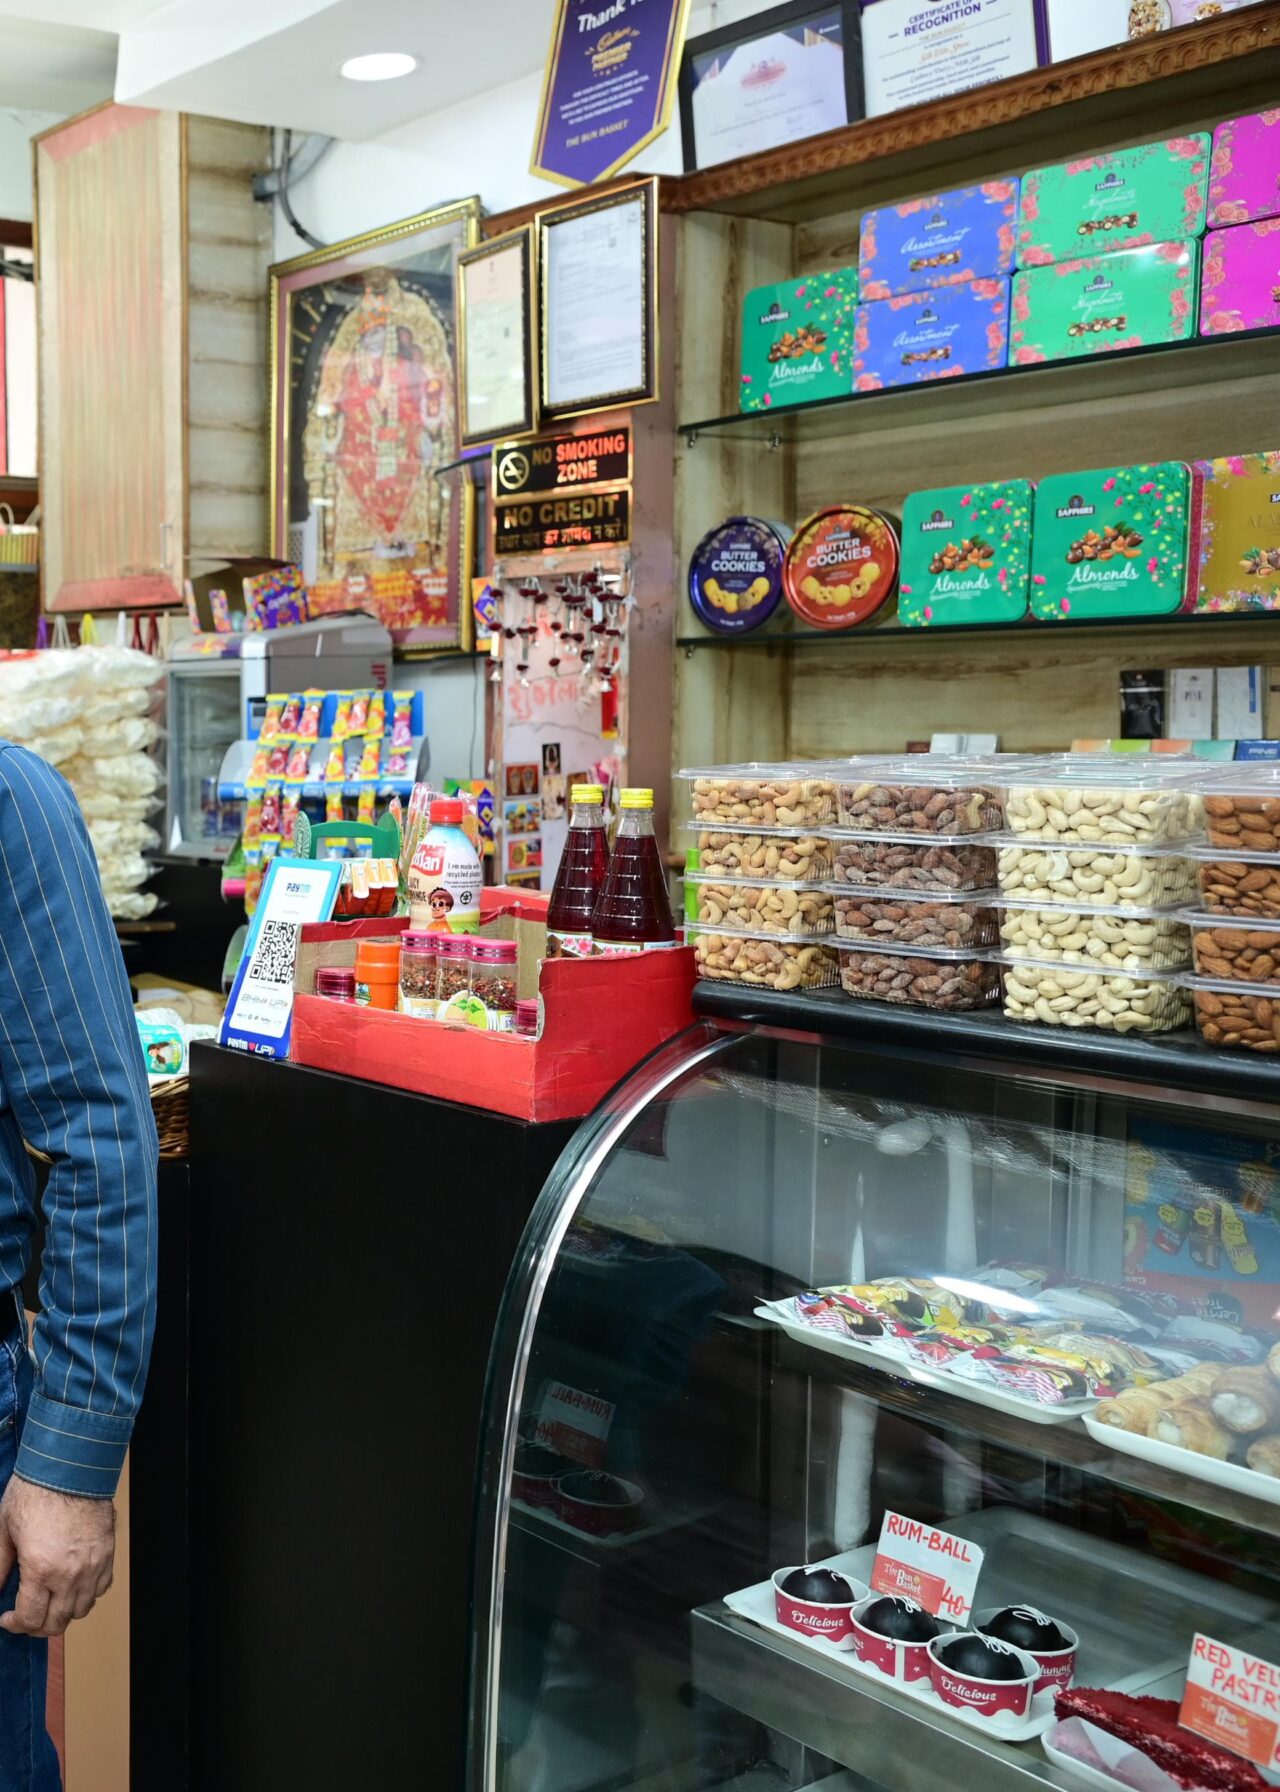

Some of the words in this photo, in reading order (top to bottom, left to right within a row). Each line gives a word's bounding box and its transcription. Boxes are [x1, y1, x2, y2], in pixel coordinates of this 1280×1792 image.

[578, 0, 626, 32] Thank
[904, 2, 982, 37] RECOGNITION
[909, 1, 961, 24] CERTIFICATE
[771, 356, 825, 380] Almonds
[532, 447, 552, 465] NO
[556, 434, 625, 462] SMOKING
[557, 459, 598, 483] ZONE
[504, 505, 533, 529] NO
[539, 494, 620, 524] CREDIT
[1057, 505, 1095, 518] SAPPHIRE
[921, 519, 954, 532] SAPPHIRE
[721, 551, 758, 561] BUTTER
[807, 546, 872, 569] COOKIES
[816, 538, 861, 555] BUTTER
[711, 560, 766, 573] COOKIES
[1070, 562, 1140, 588] Almonds
[931, 573, 992, 597] Almonds
[887, 1514, 972, 1563] RUM-BALL
[791, 1610, 844, 1627] Delicious
[1193, 1638, 1231, 1669] RED
[940, 1675, 997, 1702] Delicious
